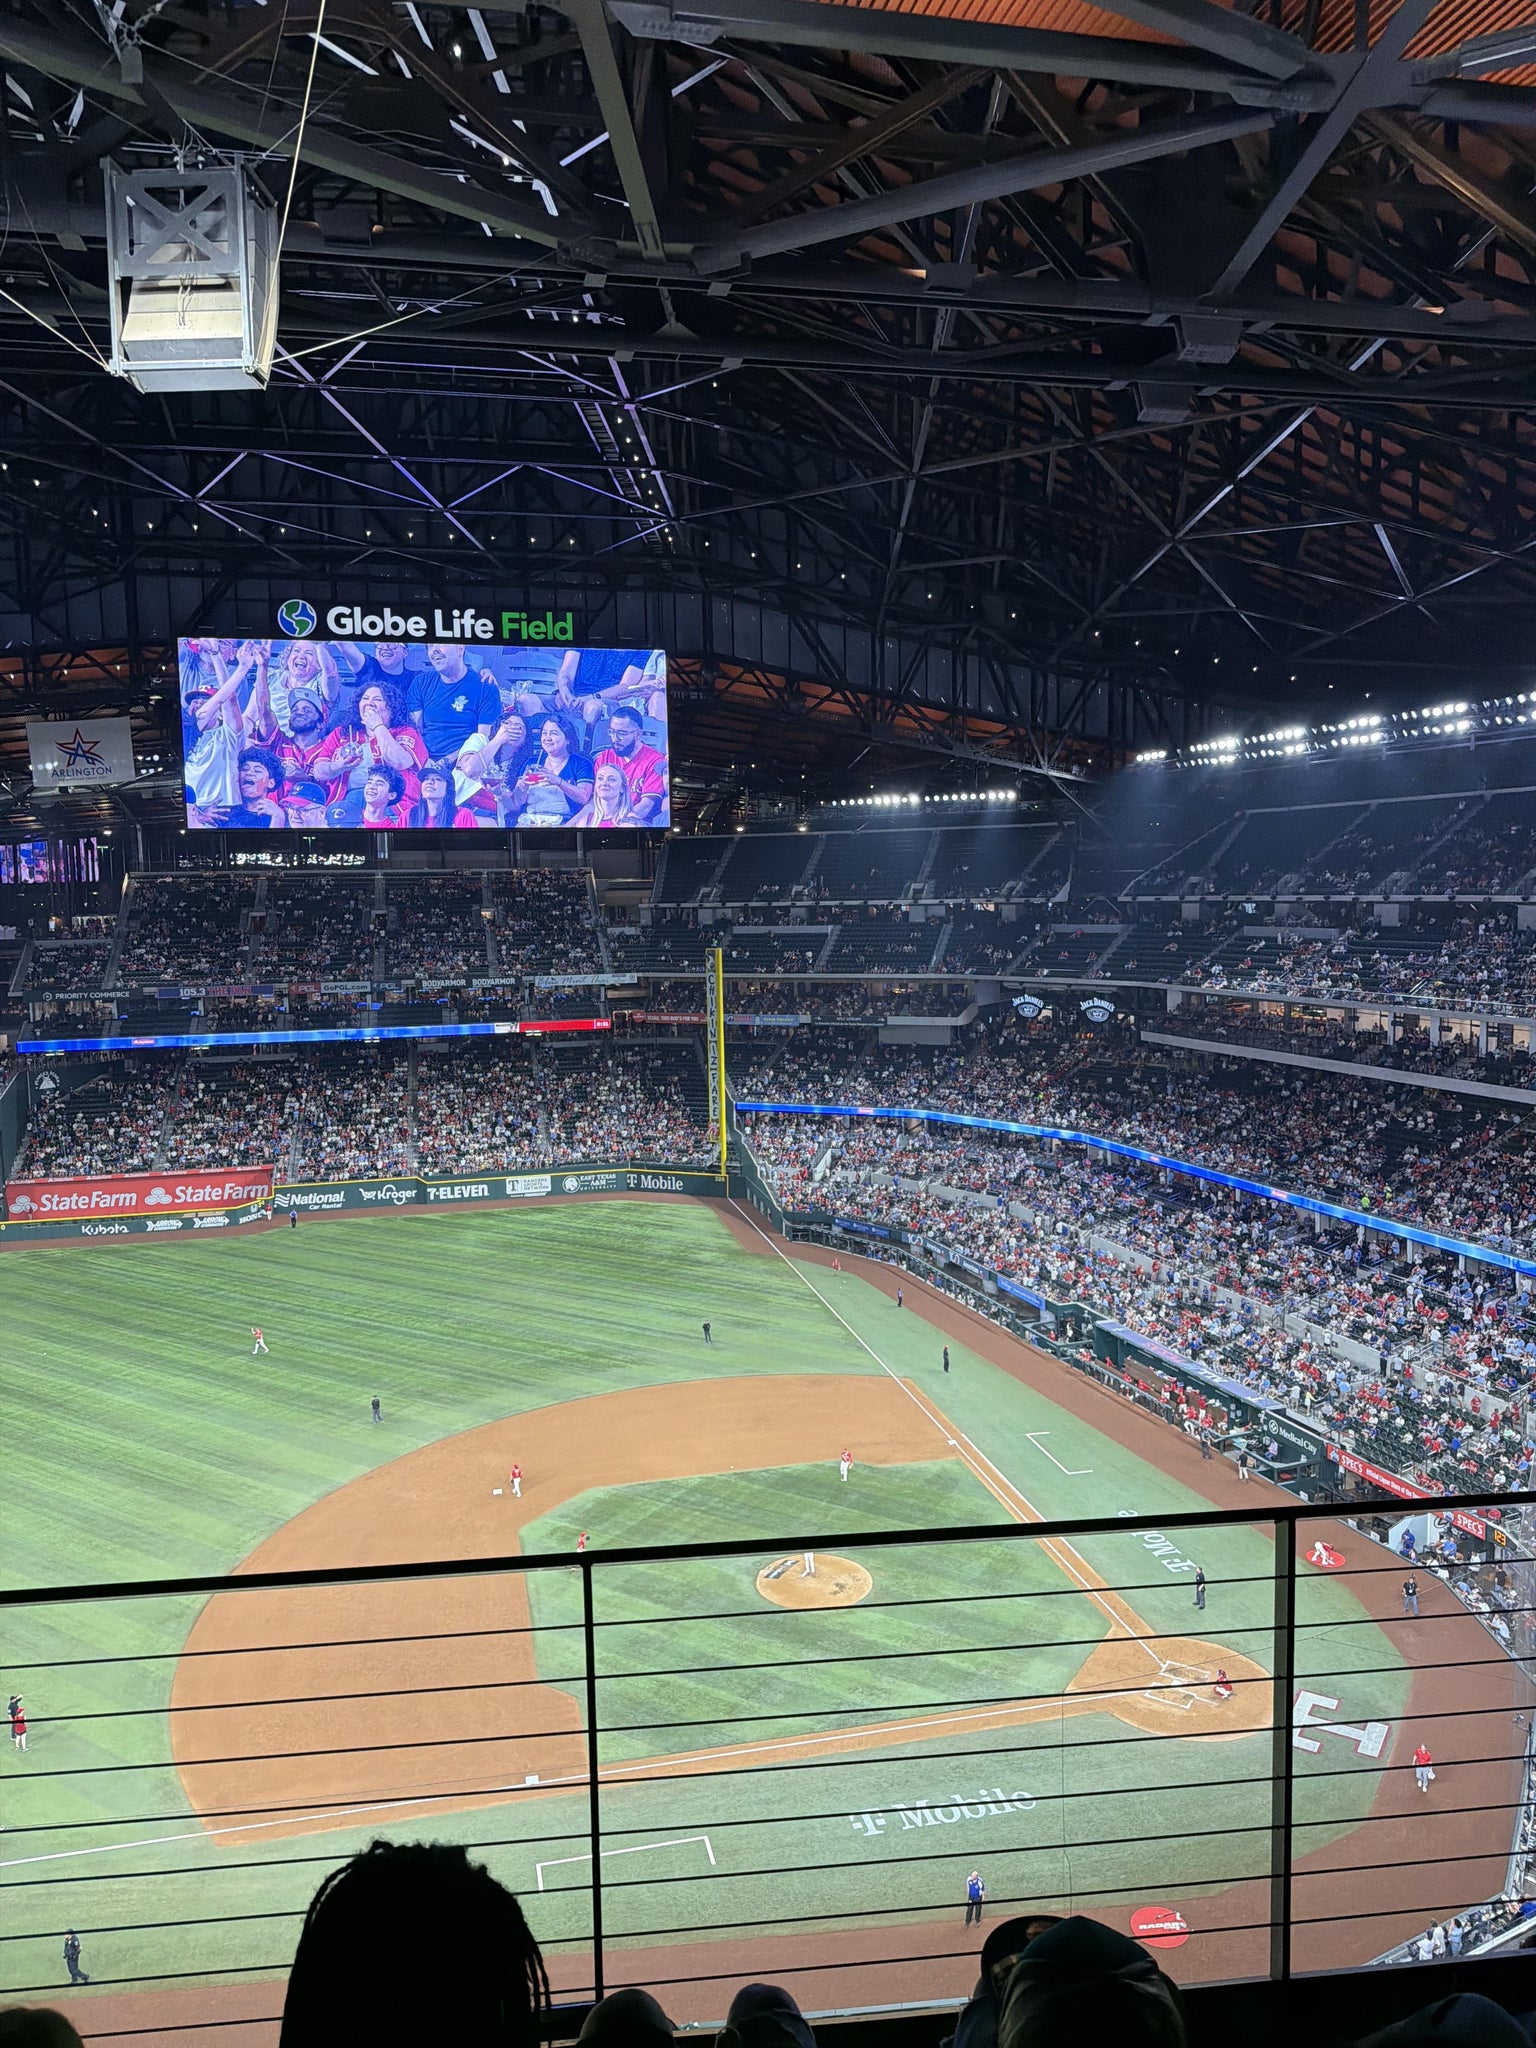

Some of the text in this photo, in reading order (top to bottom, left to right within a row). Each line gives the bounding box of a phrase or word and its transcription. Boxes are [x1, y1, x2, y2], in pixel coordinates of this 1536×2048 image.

[326, 606, 574, 641] Globe Life Field
[51, 765, 113, 778] ARLINGTON
[323, 983, 368, 992] GoPGL.com
[379, 982, 400, 991] PGL
[422, 979, 466, 988] BODYARMOR
[472, 977, 515, 986] BODYARMOR
[89, 991, 130, 999] COMMERCE
[179, 988, 206, 997] 105.3
[299, 985, 317, 993] PGL
[640, 1175, 683, 1191] Mobile
[377, 1184, 418, 1205] Kroger
[81, 1222, 129, 1236] Kubota
[1279, 1426, 1317, 1455] Medical City
[1341, 1455, 1363, 1473] SPEC'S
[1457, 1513, 1483, 1535] SPEC'S
[891, 1787, 1037, 1831] Mobile
